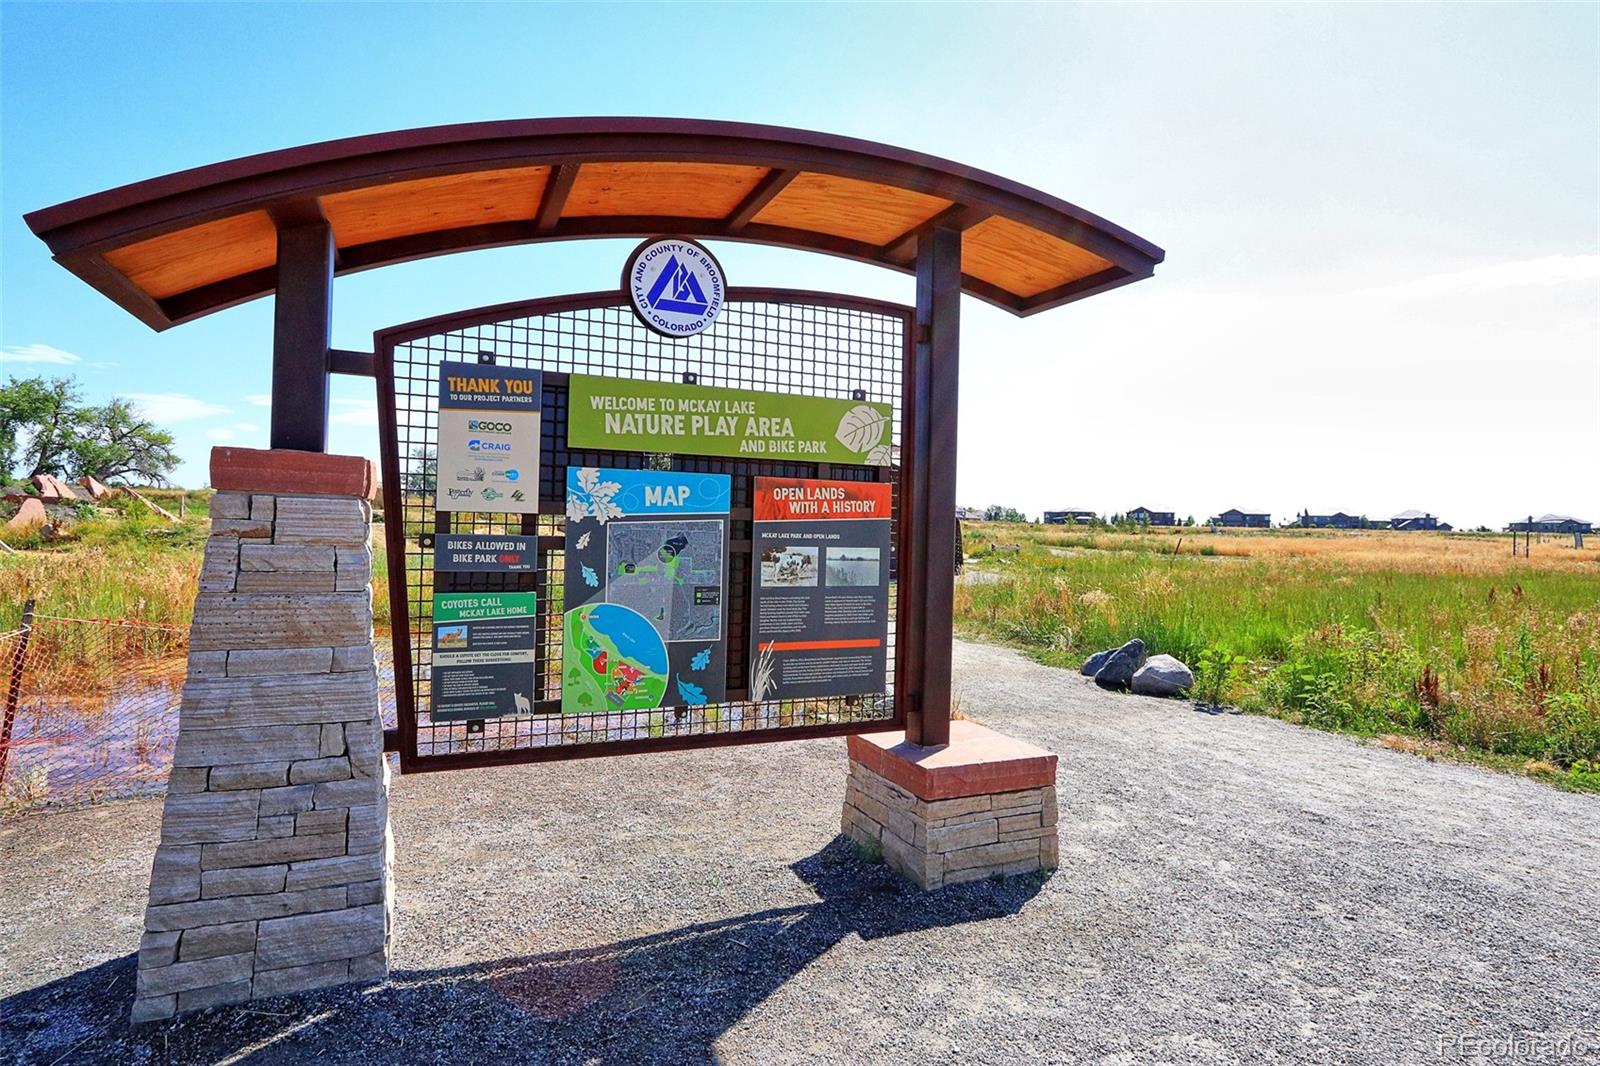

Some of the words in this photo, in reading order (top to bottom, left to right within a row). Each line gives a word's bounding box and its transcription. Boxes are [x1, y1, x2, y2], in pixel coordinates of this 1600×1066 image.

[645, 244, 684, 262] COUNTY
[686, 248, 700, 258] OF
[634, 261, 647, 283] AND
[699, 257, 721, 318] BROOMFIELD
[634, 285, 648, 310] CITY
[652, 314, 704, 332] COLORADO
[447, 376, 500, 394] THANK
[504, 379, 533, 394] YOU
[590, 396, 656, 411] WELCOME
[660, 398, 674, 412] TO
[678, 399, 722, 414] MCKAY
[724, 400, 756, 414] LAKE
[478, 421, 512, 432] GOCO
[604, 412, 686, 435] NATURE
[691, 415, 739, 436] PLAY
[744, 416, 795, 438] AREA
[482, 442, 511, 451] CRAIG
[740, 440, 766, 453] AND
[768, 440, 795, 453] BIKE
[798, 440, 827, 454] PARK
[644, 485, 691, 507] MAP
[773, 487, 804, 500] OPEN
[807, 487, 846, 500] LANDS
[788, 502, 818, 514] WITH
[821, 501, 830, 513] A
[832, 500, 876, 513] HISTORY
[447, 541, 473, 550] BIKES
[475, 541, 515, 550] ALLOWED
[516, 542, 526, 551] IN
[452, 554, 473, 563] BIKE
[474, 554, 497, 563] PARK
[498, 554, 520, 563] ONLY
[441, 599, 478, 609] COYOTES
[481, 598, 502, 607] CALL
[459, 609, 487, 618] MCKAY
[487, 607, 505, 616] LAKE
[506, 606, 528, 614] HOME
